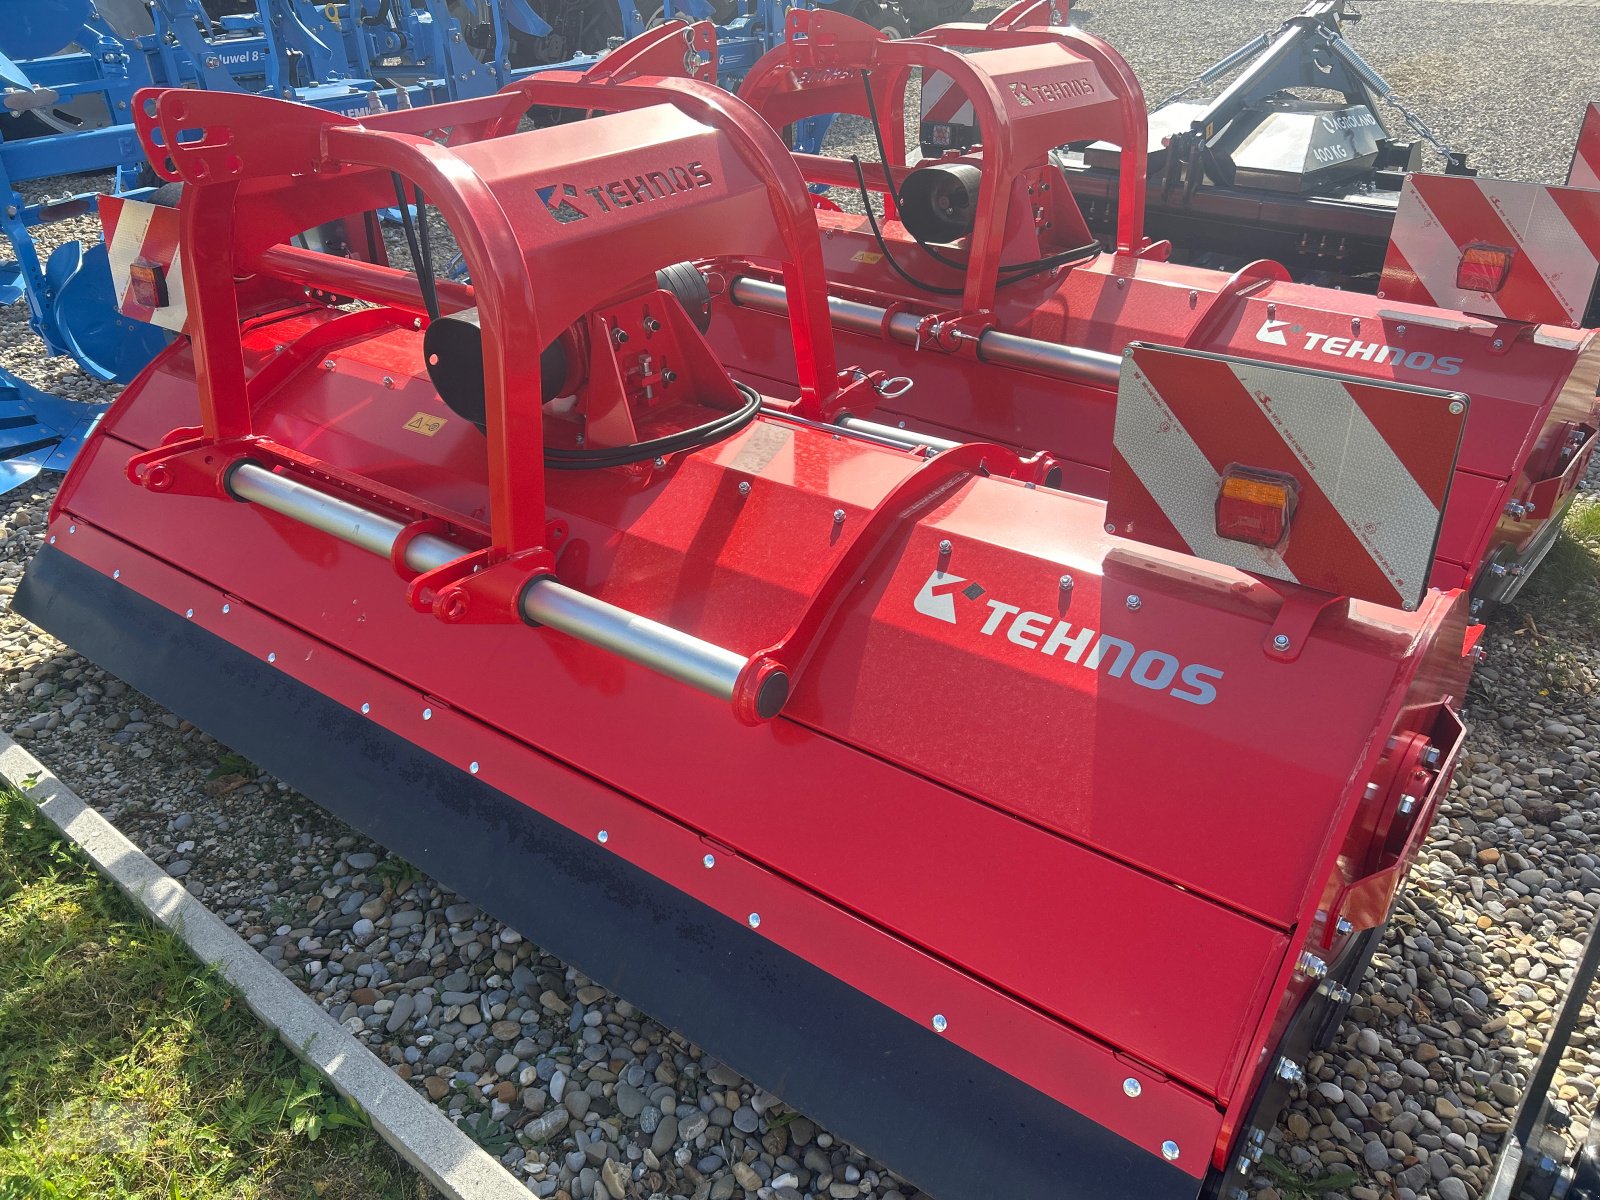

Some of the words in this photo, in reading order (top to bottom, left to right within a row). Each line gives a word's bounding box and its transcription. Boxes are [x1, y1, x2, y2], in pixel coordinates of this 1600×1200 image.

[252, 51, 259, 61] 8
[719, 54, 725, 65] 6
[1031, 78, 1094, 102] TEHNOS
[1332, 114, 1376, 129] AGROLAND
[1313, 146, 1334, 162] 400
[1330, 144, 1347, 159] KG
[584, 161, 713, 213] TEHNOS
[1303, 331, 1464, 375] TEHNOS
[979, 598, 1225, 705] TEHNOS
